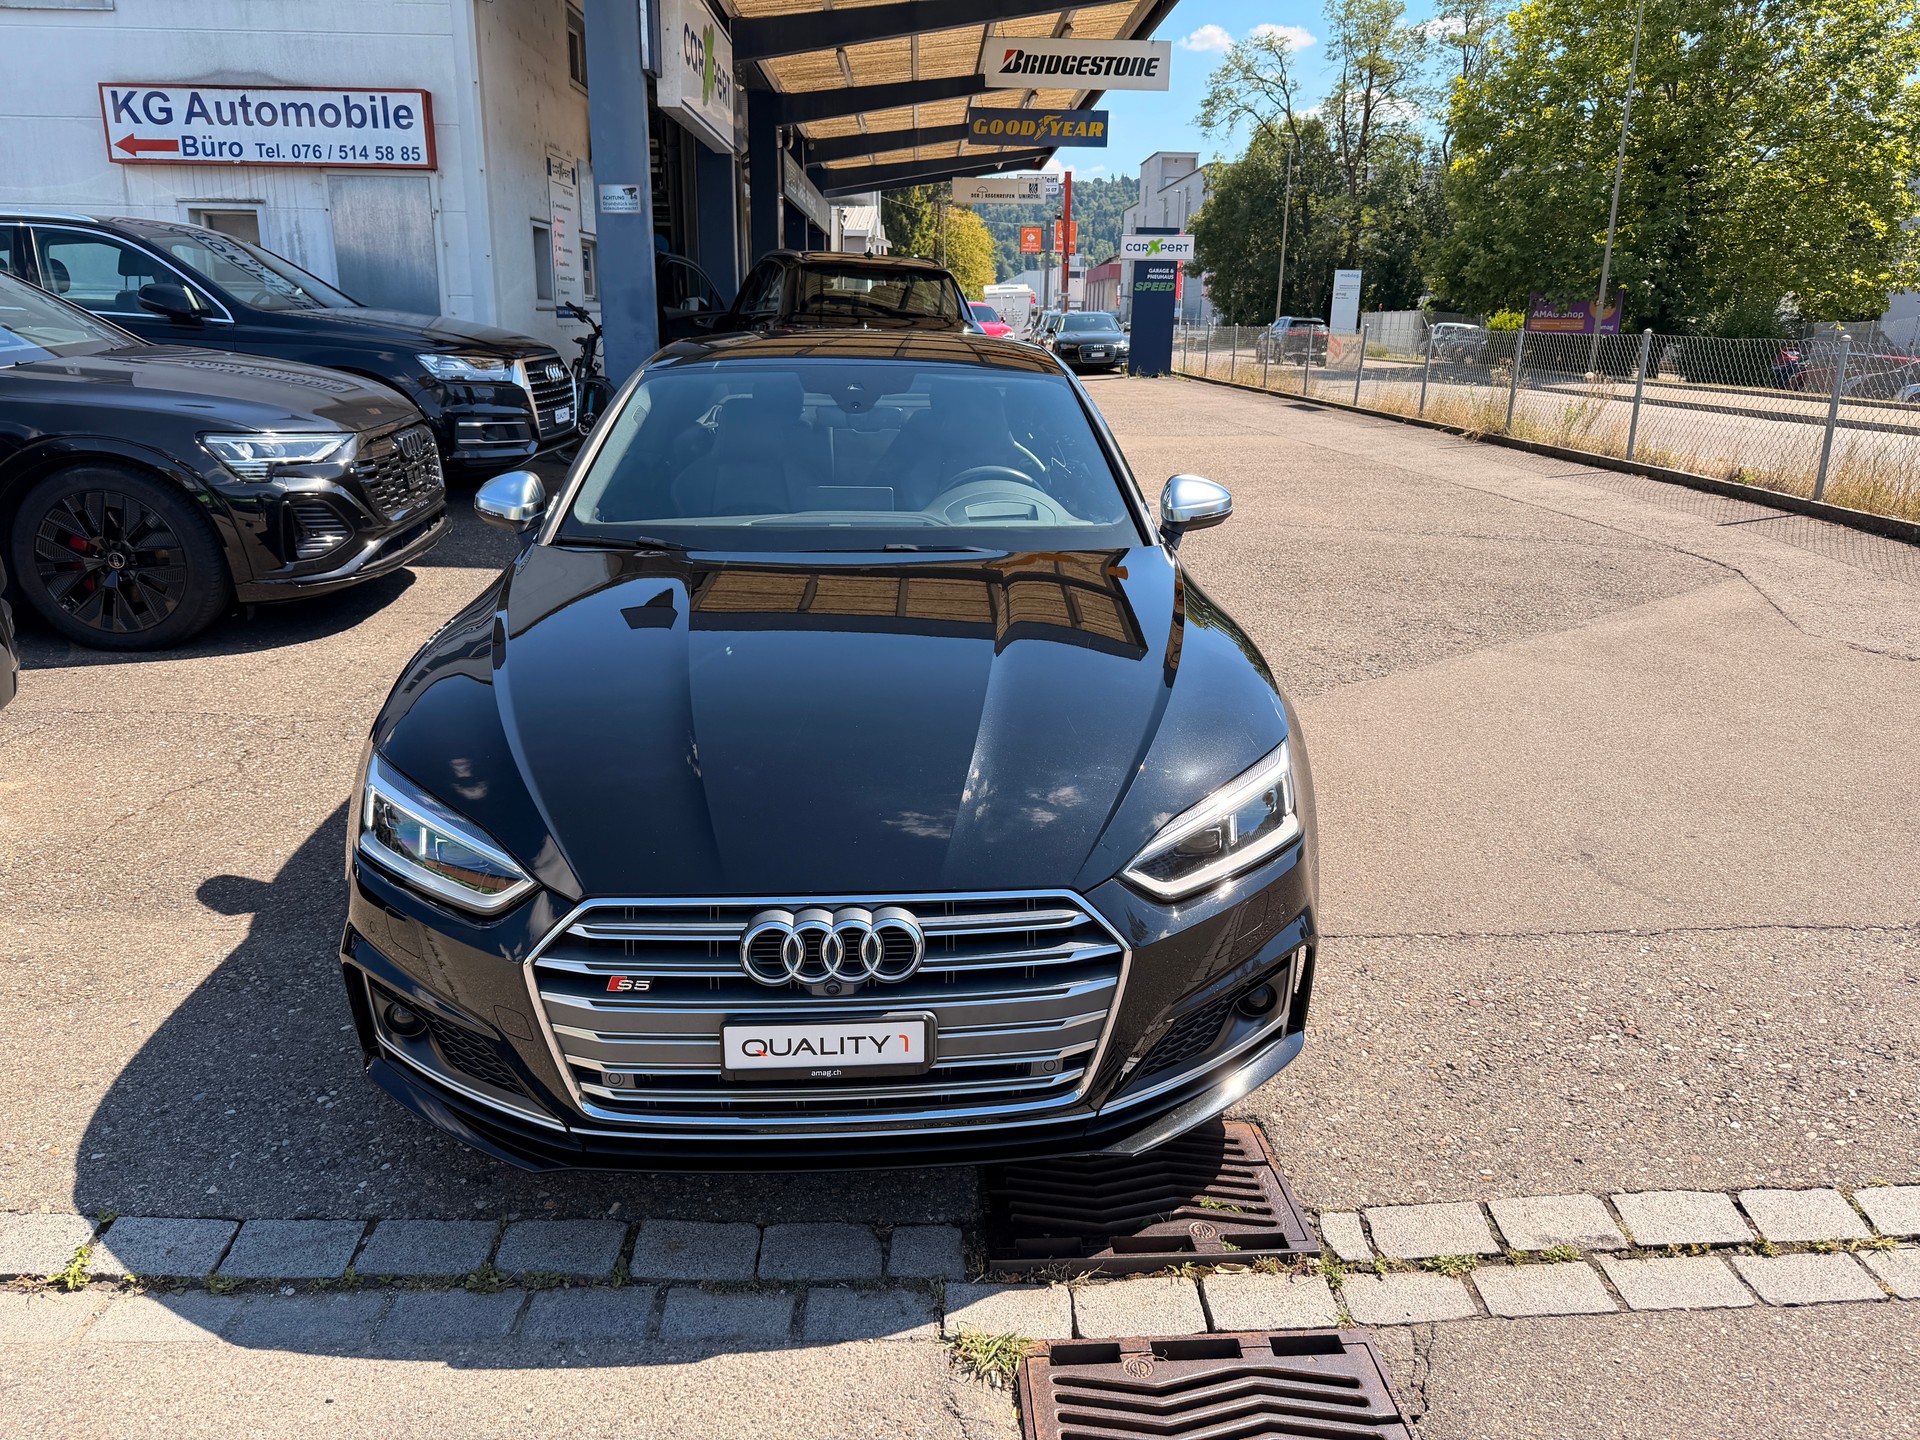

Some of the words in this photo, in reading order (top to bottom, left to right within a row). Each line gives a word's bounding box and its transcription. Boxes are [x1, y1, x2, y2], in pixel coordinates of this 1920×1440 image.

[999, 49, 1160, 77] BRIDGESTONE
[110, 90, 174, 125] KG
[184, 91, 414, 129] Automobile
[181, 135, 244, 158] Büro
[255, 142, 286, 158] Tel.
[292, 144, 322, 159] 076
[338, 145, 369, 160] 514
[375, 145, 395, 161] 58
[400, 146, 421, 162] 85
[1135, 282, 1175, 291] SPEED
[616, 979, 651, 991] S5
[742, 1035, 891, 1058] QUALITY
[811, 1068, 842, 1077] amag.ch
